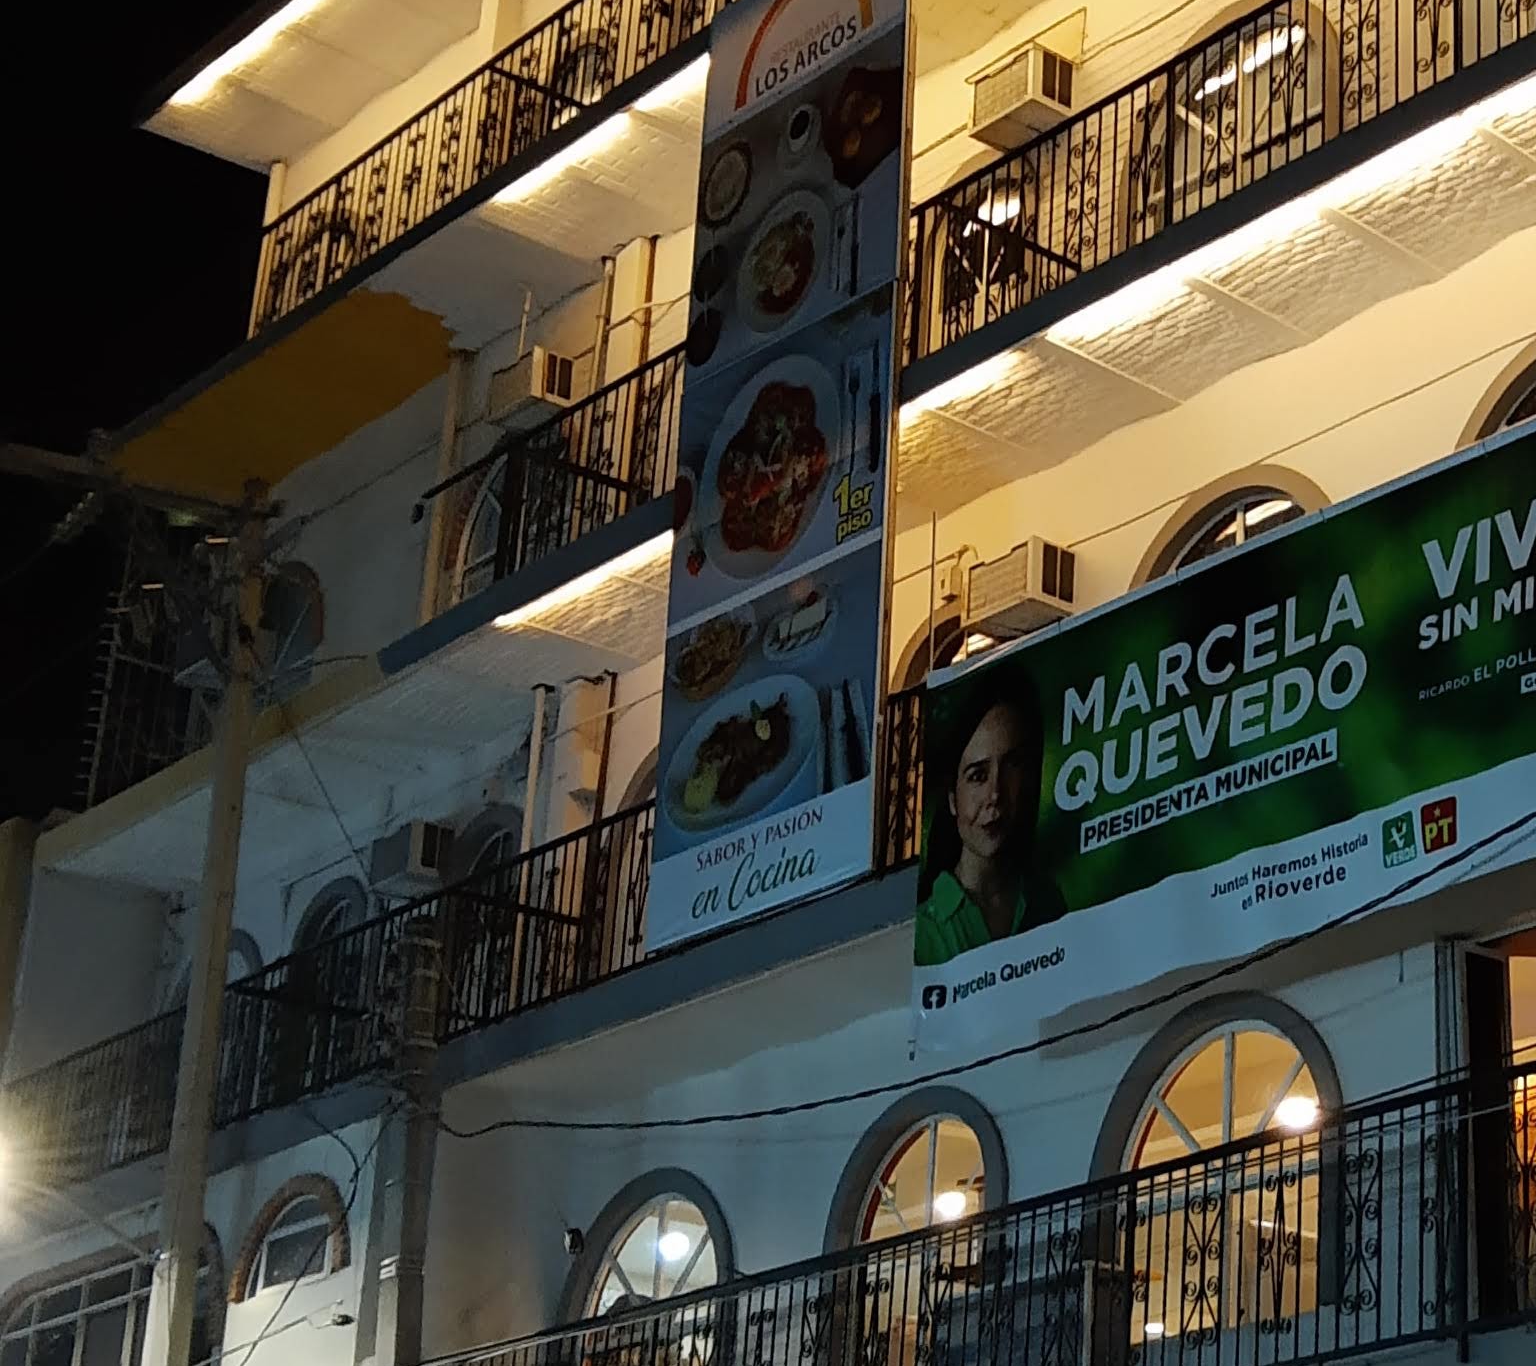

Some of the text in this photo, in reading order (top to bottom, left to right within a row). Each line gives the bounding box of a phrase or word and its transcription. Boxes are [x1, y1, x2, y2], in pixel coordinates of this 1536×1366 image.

[755, 15, 857, 98] LOS ARCOS
[832, 473, 875, 518] 1er
[835, 509, 873, 546] piso
[1418, 596, 1479, 651] SIN
[1061, 573, 1366, 746] MARCELA
[1418, 674, 1471, 702] RICARDO
[1473, 662, 1492, 684] EL
[1053, 644, 1369, 813] QUEVEDO
[1083, 736, 1334, 849] PRESIDENTA MUNICIPAL
[695, 804, 824, 873] SABOR Y PASIÓN
[1424, 815, 1454, 851] PT
[690, 846, 821, 920] en Cocina
[1210, 832, 1369, 899] Juntos Haremos Historia
[1254, 863, 1348, 904] Rioverde
[999, 945, 1067, 983] Quevedo
